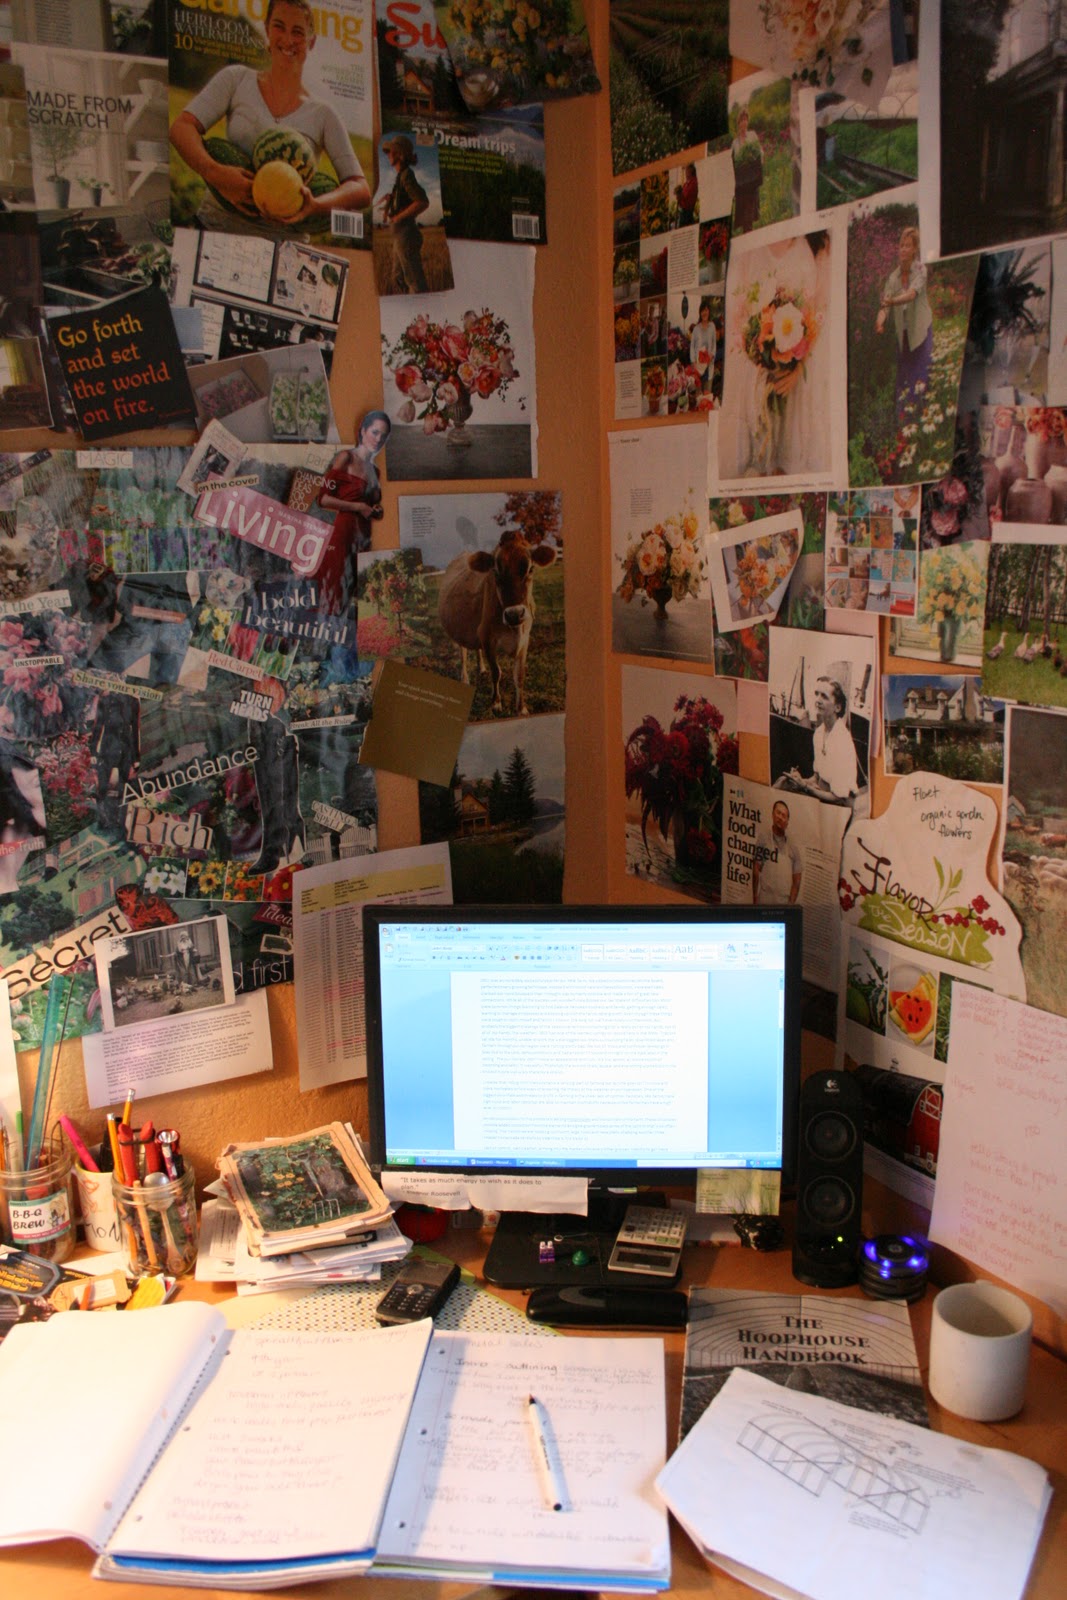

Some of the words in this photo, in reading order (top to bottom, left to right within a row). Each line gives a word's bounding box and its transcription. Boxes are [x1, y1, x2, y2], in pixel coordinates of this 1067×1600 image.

[174, 9, 250, 36] HEIRLOOM
[174, 22, 265, 49] WATERMELONS
[174, 33, 193, 50] 10
[27, 91, 77, 110] MADE
[84, 96, 133, 114] FROM
[28, 109, 109, 129] SCRATCH
[434, 129, 480, 149] Dream
[484, 137, 517, 155] trips
[58, 326, 88, 348] Go
[92, 313, 143, 342] forth
[67, 347, 106, 374] and
[111, 342, 141, 364] set
[73, 378, 106, 399] the
[112, 360, 171, 391] world
[83, 408, 110, 425] on
[113, 397, 155, 420] fire.
[79, 452, 131, 467] MAGIC
[210, 480, 228, 491] the
[229, 476, 259, 487] cover
[197, 490, 326, 574] Living
[12, 600, 34, 613] the
[37, 597, 69, 609] Year
[262, 587, 317, 611] bold
[245, 606, 348, 644] beautiful
[208, 652, 227, 668] Red
[228, 659, 262, 678] Carpet
[74, 671, 105, 686] Share
[107, 680, 131, 693] your
[132, 686, 162, 700] vision
[240, 690, 272, 709] TURN
[230, 701, 269, 722] HEADS
[121, 746, 259, 805] Abundance
[729, 800, 761, 823] What
[921, 806, 952, 831] organic
[128, 807, 213, 850] Rich
[728, 817, 755, 838] food
[17, 837, 44, 852] Truth
[728, 835, 778, 863] changed
[727, 851, 754, 870] your
[727, 865, 751, 886] life?
[261, 906, 292, 925] Idea
[2, 912, 128, 1000] Secret
[251, 954, 290, 986] first
[12, 1208, 42, 1219] B-B-Q
[781, 1315, 823, 1329] THE
[738, 1328, 871, 1349] HOOPHOUSE
[743, 1346, 869, 1365] HANDBOOK
